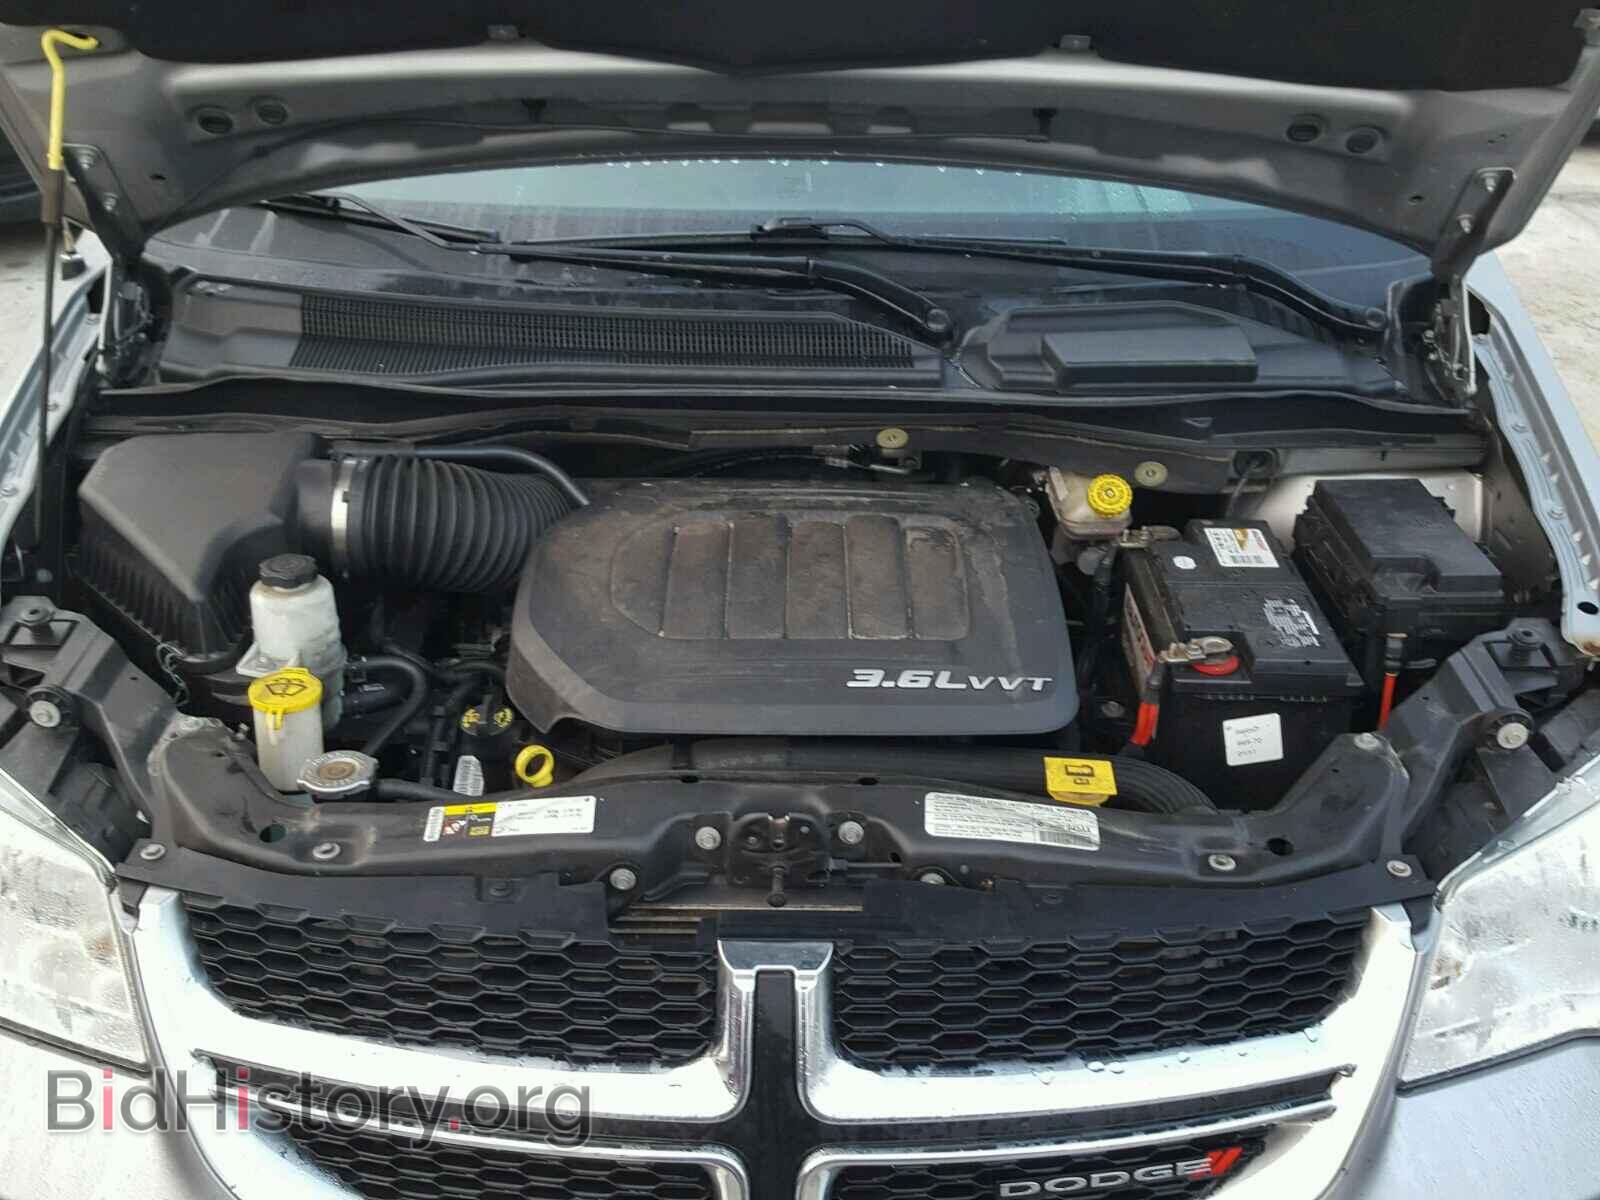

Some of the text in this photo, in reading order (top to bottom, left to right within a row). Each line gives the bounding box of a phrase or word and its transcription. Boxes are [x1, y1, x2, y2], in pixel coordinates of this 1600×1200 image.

[846, 668, 1053, 691] 3.6L VVT
[999, 1157, 1212, 1198] DODGE
